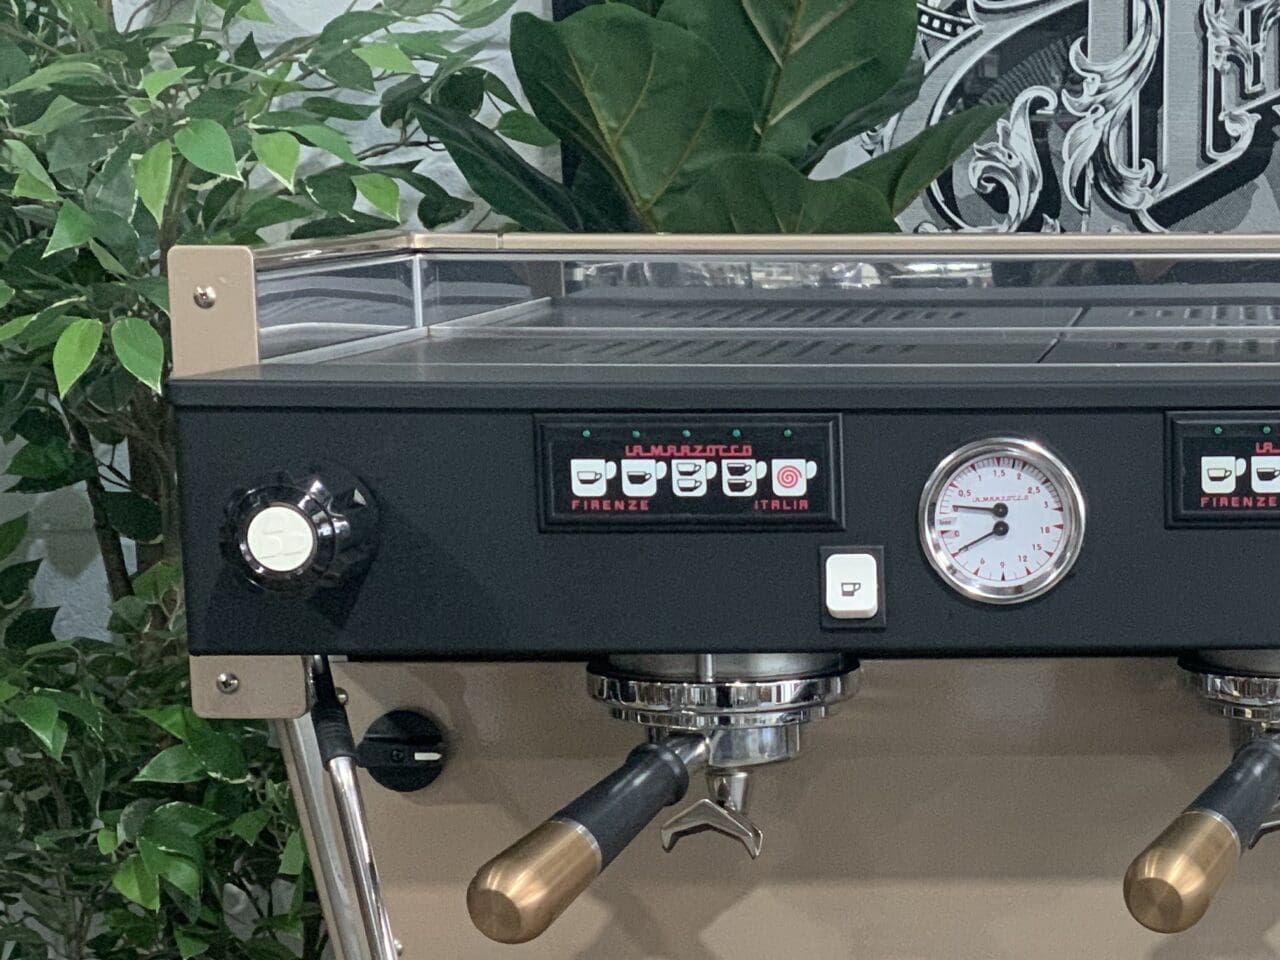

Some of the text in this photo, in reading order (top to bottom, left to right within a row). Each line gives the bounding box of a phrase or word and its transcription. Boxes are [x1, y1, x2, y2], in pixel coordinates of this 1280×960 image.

[571, 500, 649, 511] FIRENZE
[754, 500, 808, 510] ITALIA
[1200, 496, 1278, 507] FIRENZE
